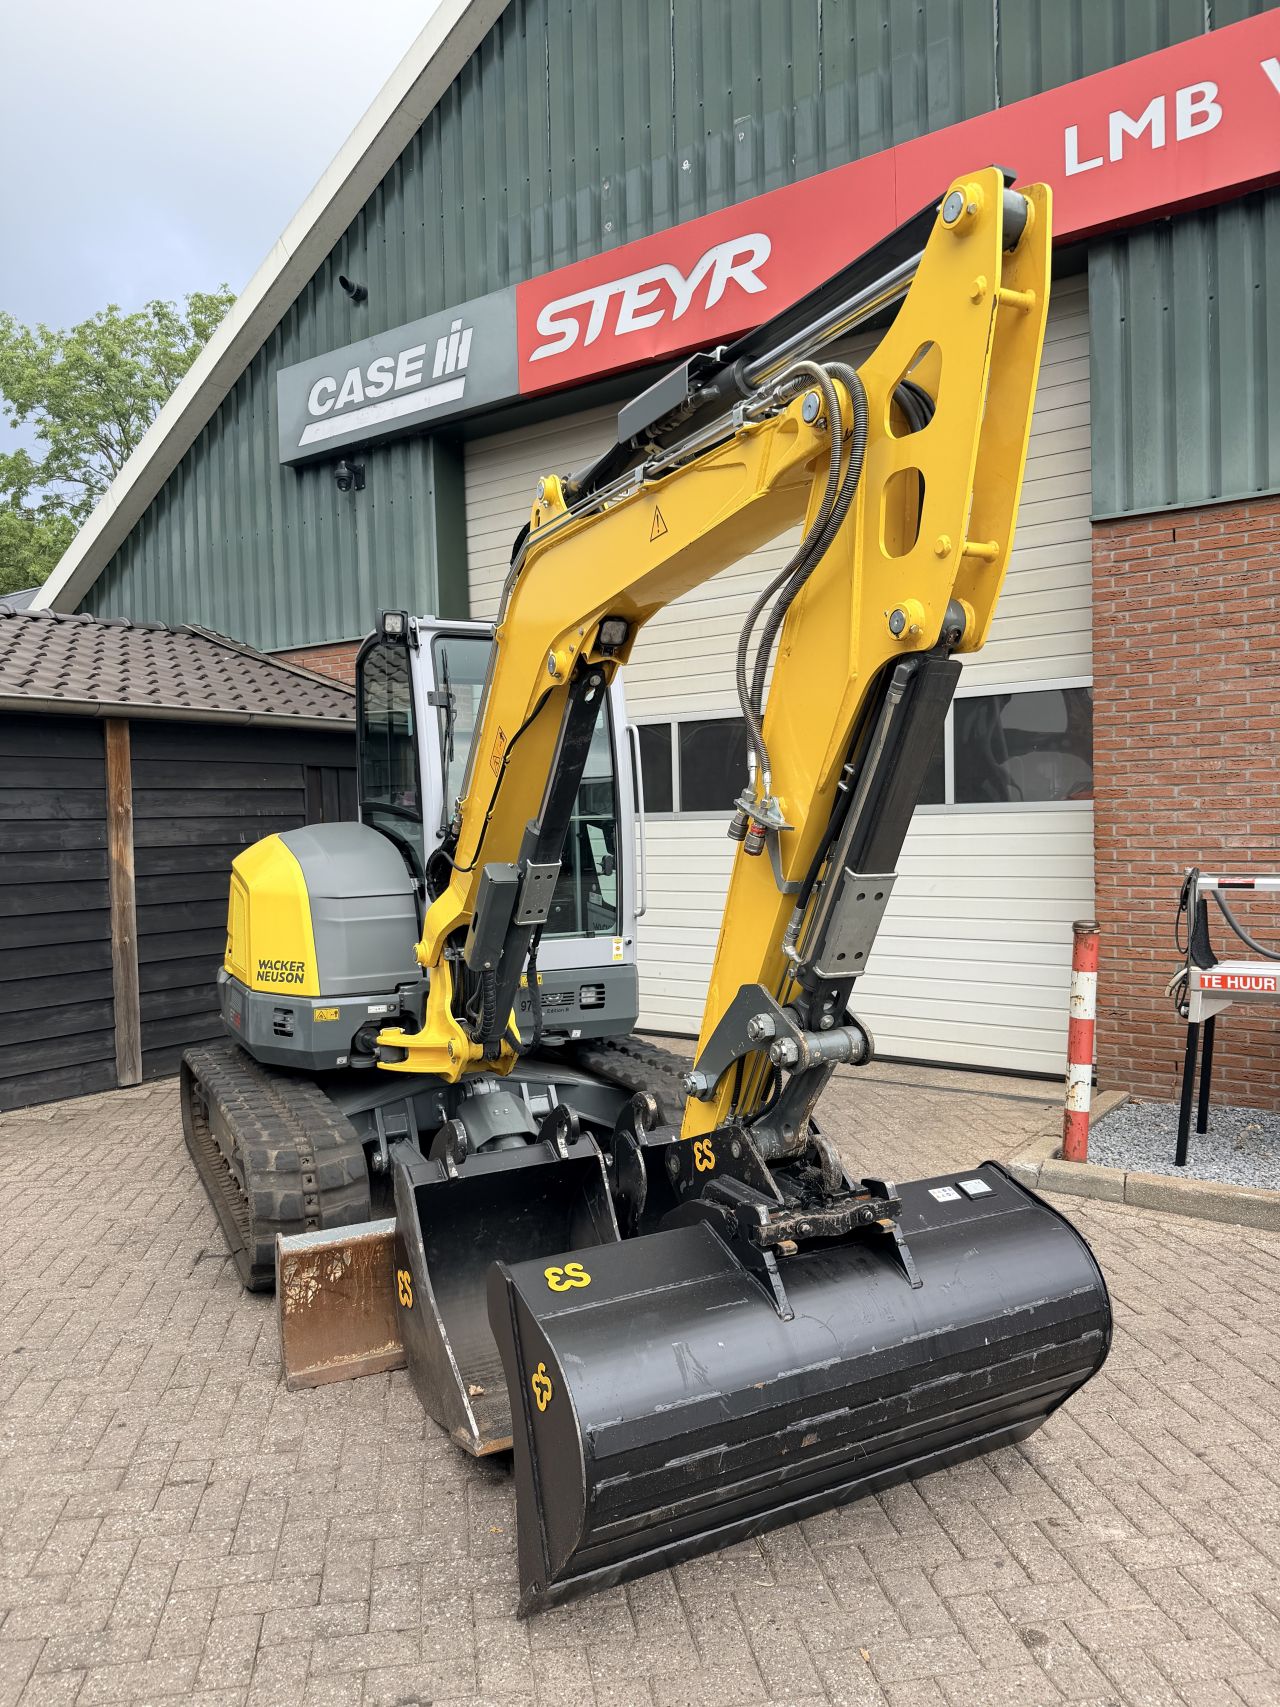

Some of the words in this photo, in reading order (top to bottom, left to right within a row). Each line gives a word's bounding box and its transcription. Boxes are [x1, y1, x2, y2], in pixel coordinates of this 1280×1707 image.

[1064, 80, 1224, 177] LMB
[528, 232, 772, 363] STEYR
[307, 343, 427, 417] CASE
[256, 971, 305, 984] NEUSON
[258, 959, 306, 973] WACKER
[1201, 975, 1222, 988] TE
[1227, 976, 1276, 990] HUUR
